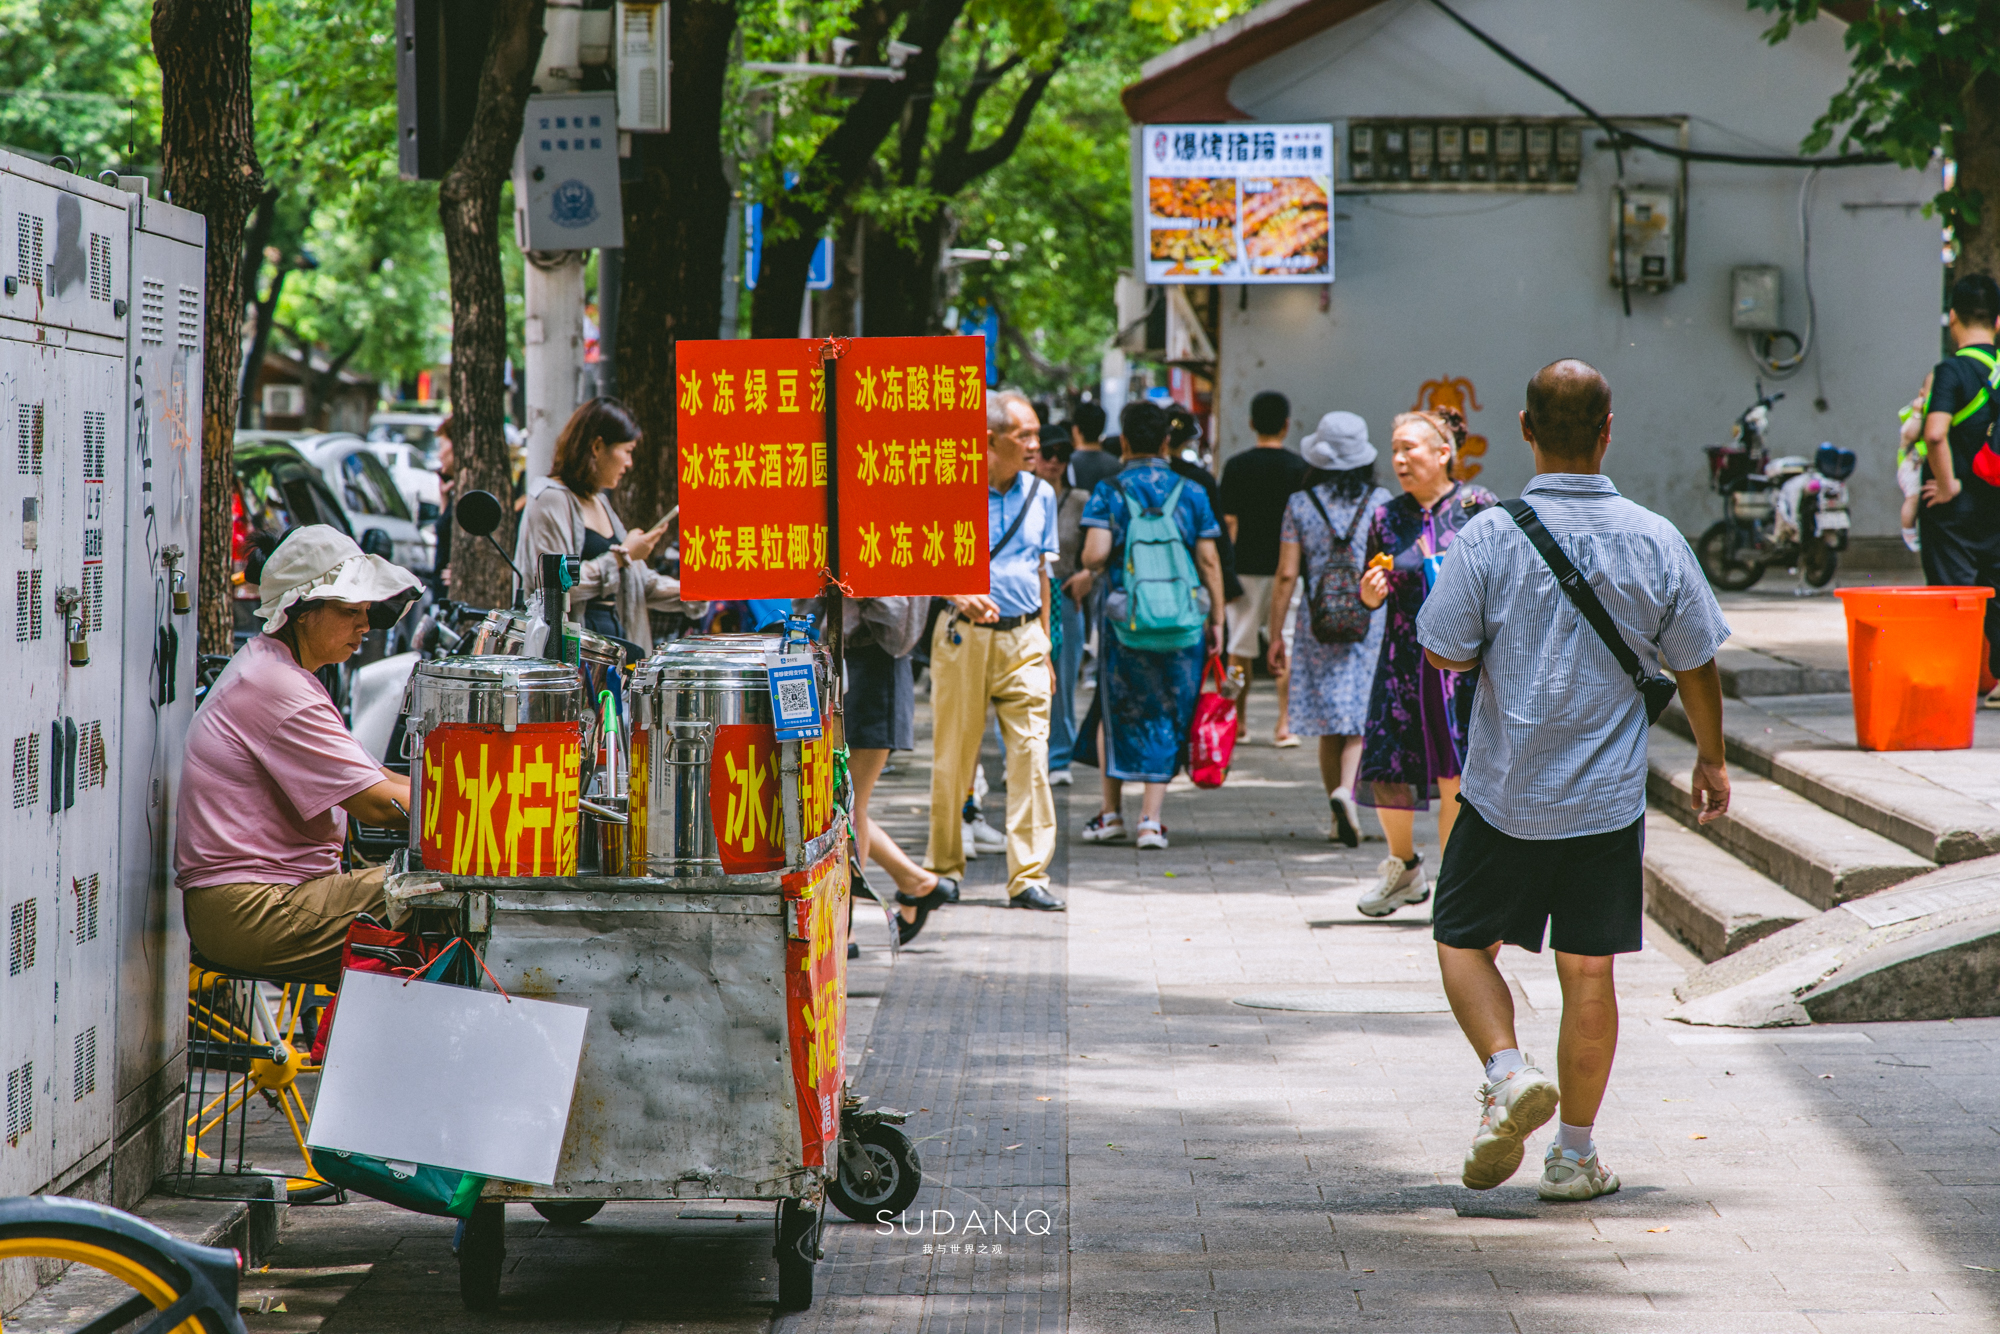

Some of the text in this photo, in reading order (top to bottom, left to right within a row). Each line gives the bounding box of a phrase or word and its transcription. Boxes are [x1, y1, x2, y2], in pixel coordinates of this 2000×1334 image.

[679, 369, 827, 416] 冰冻绿豆汤
[855, 364, 982, 413] 冰冻酸梅汤
[681, 442, 828, 490] 冰冻米酒汤圆
[856, 437, 983, 487] 冰冻柠檬汁
[683, 523, 829, 572] 冰冻果粒椰奶
[858, 520, 977, 568] 冰冻冰粉
[797, 728, 822, 738] 推荐使
